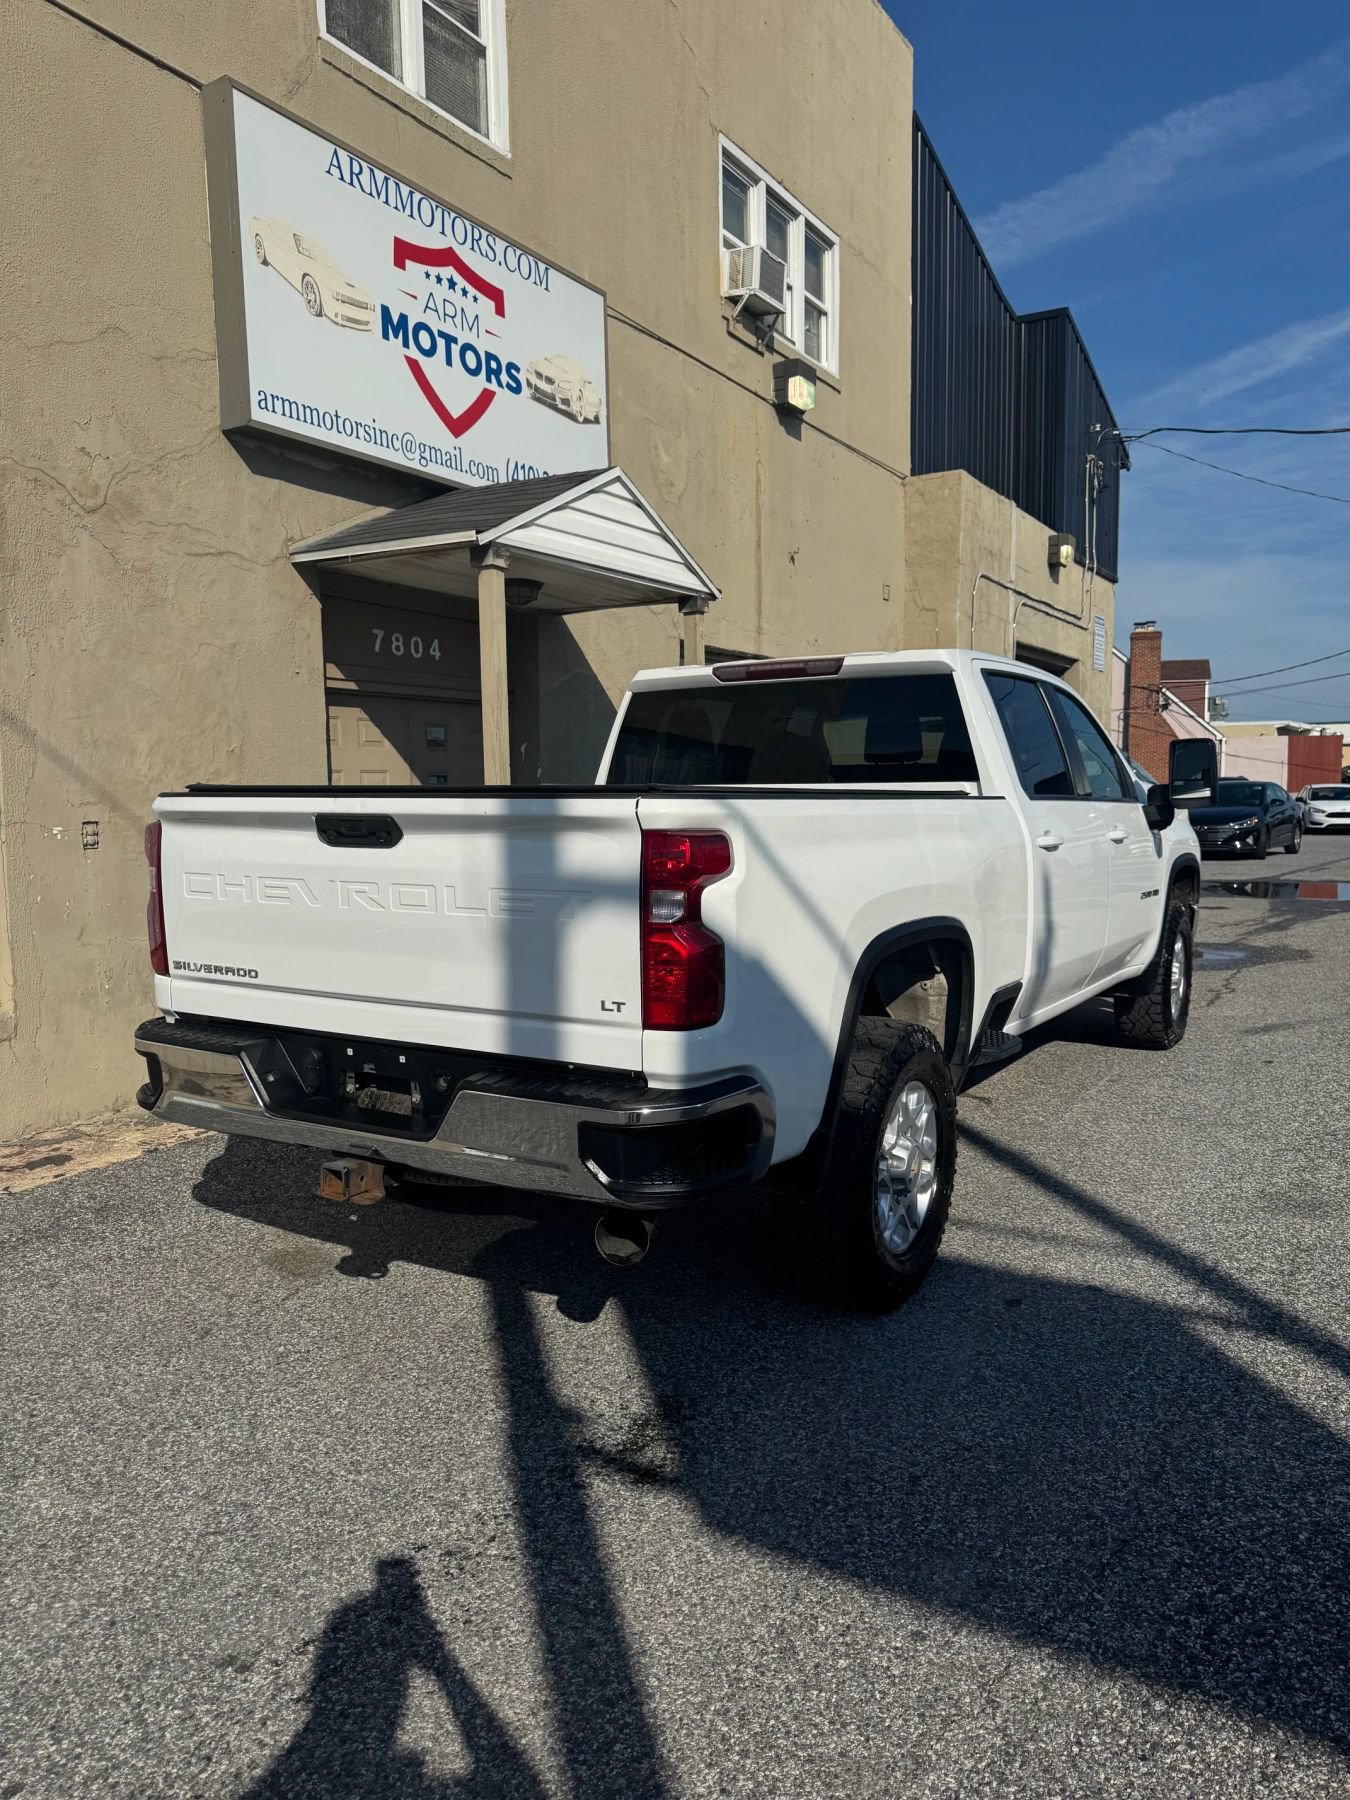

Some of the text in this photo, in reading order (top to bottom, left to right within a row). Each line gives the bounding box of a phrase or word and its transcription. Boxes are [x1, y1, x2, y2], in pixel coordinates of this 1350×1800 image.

[325, 147, 551, 292] ARMMOTORS.COM
[423, 292, 480, 338] ARM
[380, 304, 523, 395] MOTORS
[257, 388, 549, 484] armmotorsinc@gmail.com (410
[372, 628, 442, 661] 7804
[183, 871, 593, 921] CHEVROLET
[173, 960, 259, 979] SILVERADO
[600, 1000, 626, 1013] LT
